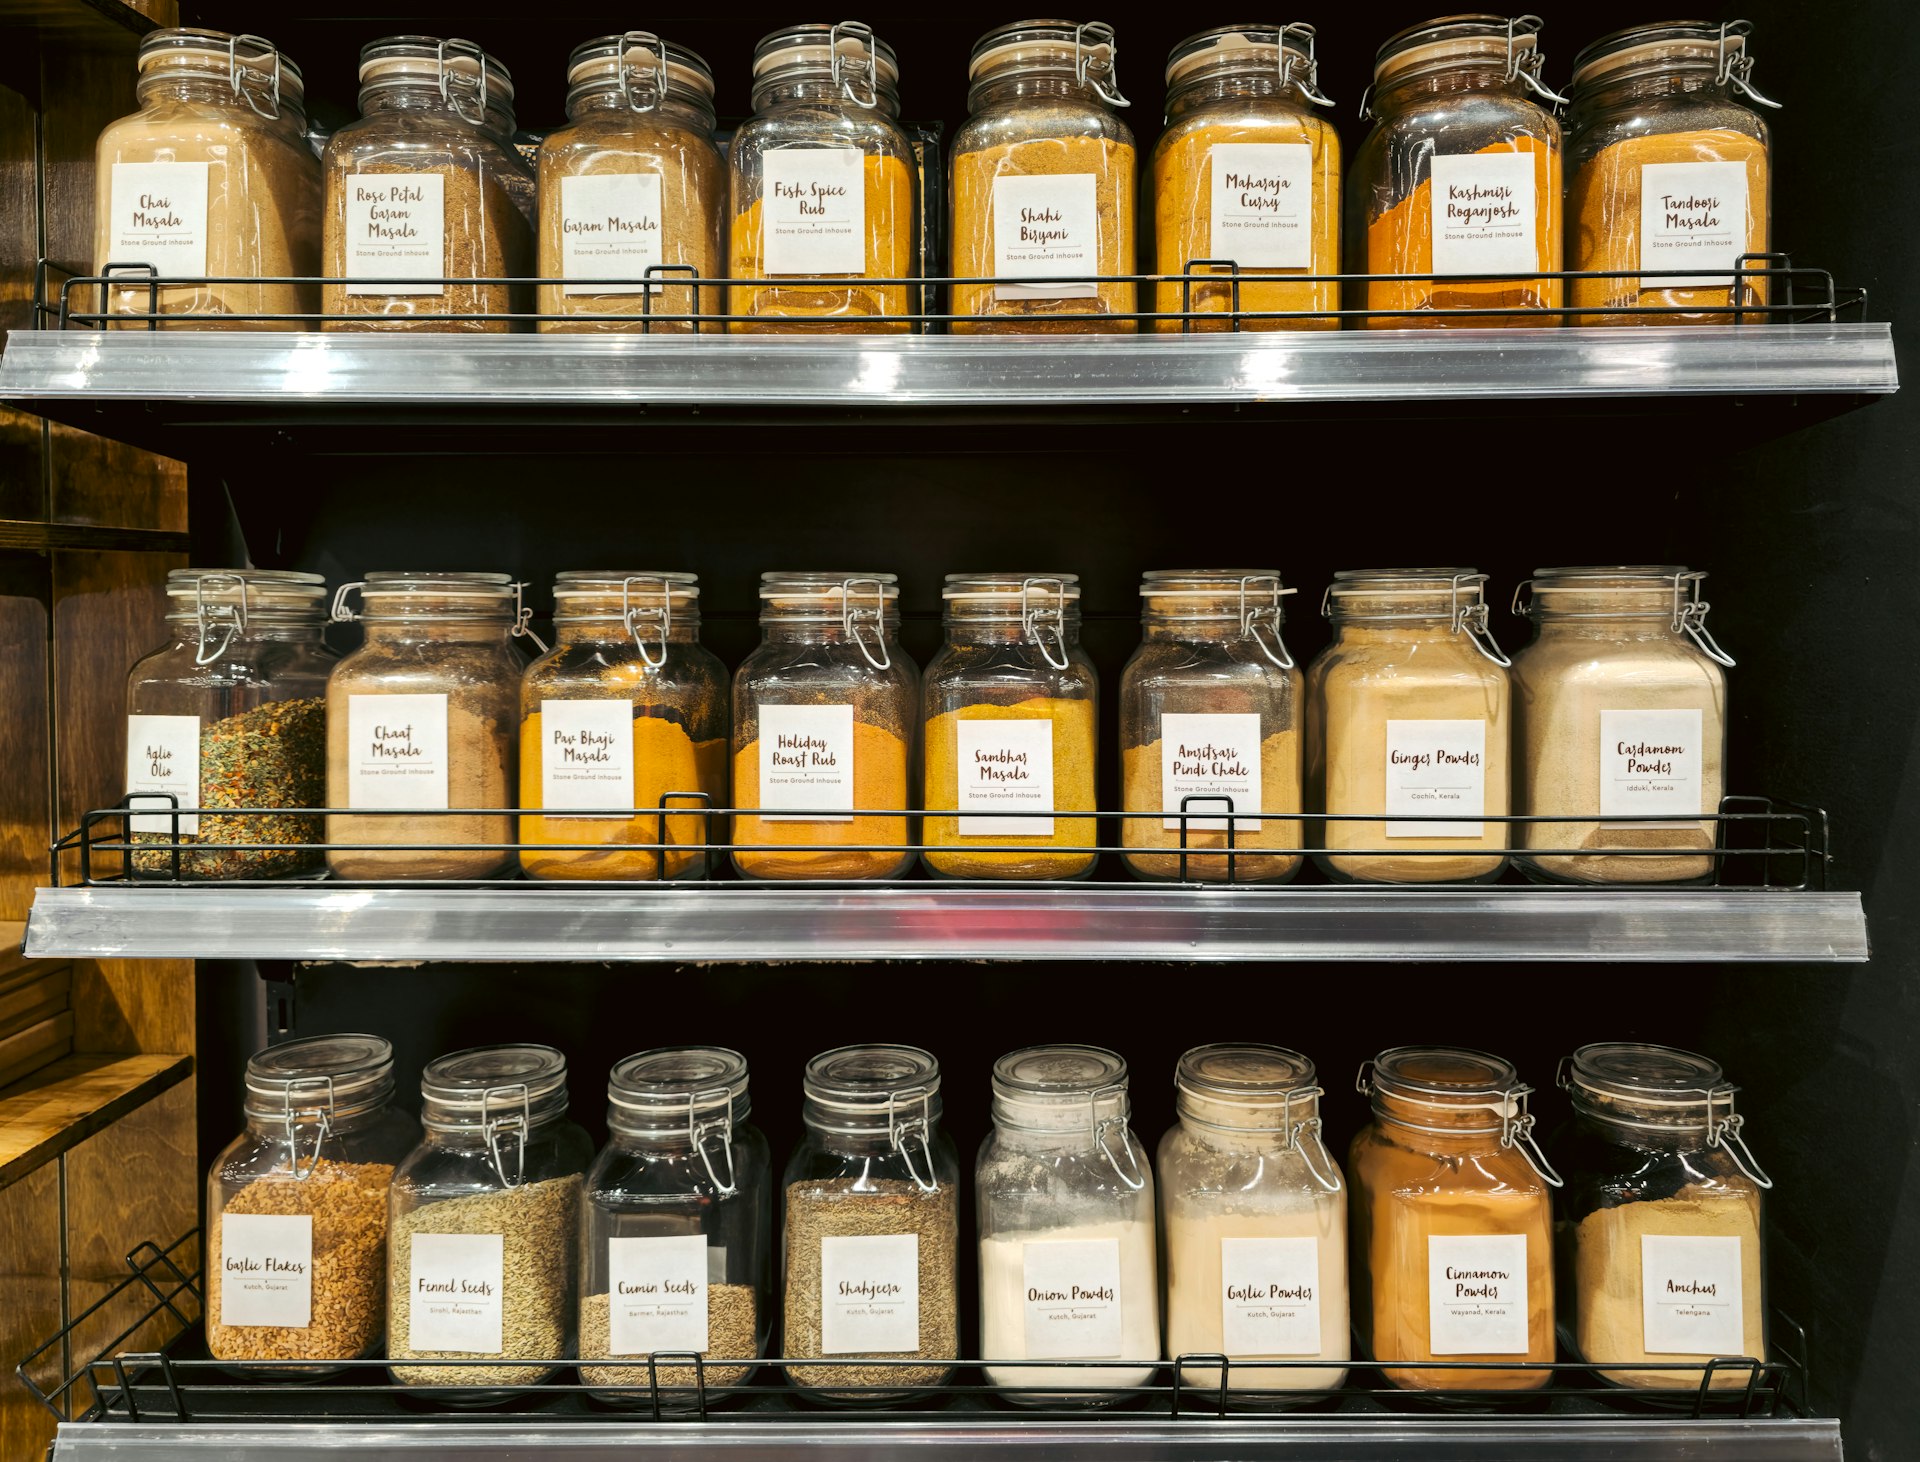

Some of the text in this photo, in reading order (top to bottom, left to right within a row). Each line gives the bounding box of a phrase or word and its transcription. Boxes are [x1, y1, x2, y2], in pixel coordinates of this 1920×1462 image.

[775, 181, 846, 202] Fish Spice
[1226, 174, 1291, 196] Maharaja
[1449, 184, 1512, 201] Kashmiri
[140, 195, 171, 210] Chai
[356, 186, 424, 203] Rose Petal
[1241, 193, 1280, 212] Curry
[1660, 195, 1720, 211] Tandoori
[370, 205, 410, 222] Garam
[799, 201, 825, 215] Rub
[1021, 207, 1062, 224] Shahi
[1447, 201, 1520, 224] Roganjosh
[133, 212, 182, 228] Masala
[563, 216, 658, 235] Garam Masala
[1665, 212, 1720, 230] Masala
[368, 223, 417, 239] Masala
[1020, 226, 1068, 244] Biryani
[375, 724, 413, 741] Chaat
[554, 730, 615, 750] Pav Bhaji
[372, 743, 422, 759] Masala
[778, 734, 828, 752] Holiday
[1178, 743, 1238, 760] Amritsari
[1617, 741, 1685, 757] Cardamom
[146, 745, 172, 764] Aglio
[564, 748, 611, 763] Masala
[772, 751, 836, 768] Roast Rub
[975, 749, 1027, 765] Sambhar
[1391, 750, 1479, 770] Ginger Powder
[151, 762, 173, 777] Olio
[980, 766, 1029, 782] Masala
[1173, 761, 1249, 776] Pindi Chole
[1627, 758, 1671, 775] Powder
[226, 1257, 306, 1274] Garlic Flakes
[1446, 1266, 1510, 1280] Cinnamon
[418, 1278, 494, 1296] Fennel Seeds
[618, 1279, 698, 1295] Cumin Seeds
[839, 1280, 901, 1299] Shahjeera
[1028, 1286, 1114, 1301] Onion Powder
[1227, 1284, 1312, 1301] Garlic Powder
[1456, 1283, 1498, 1299] Powder
[1666, 1279, 1716, 1296] Amchur
